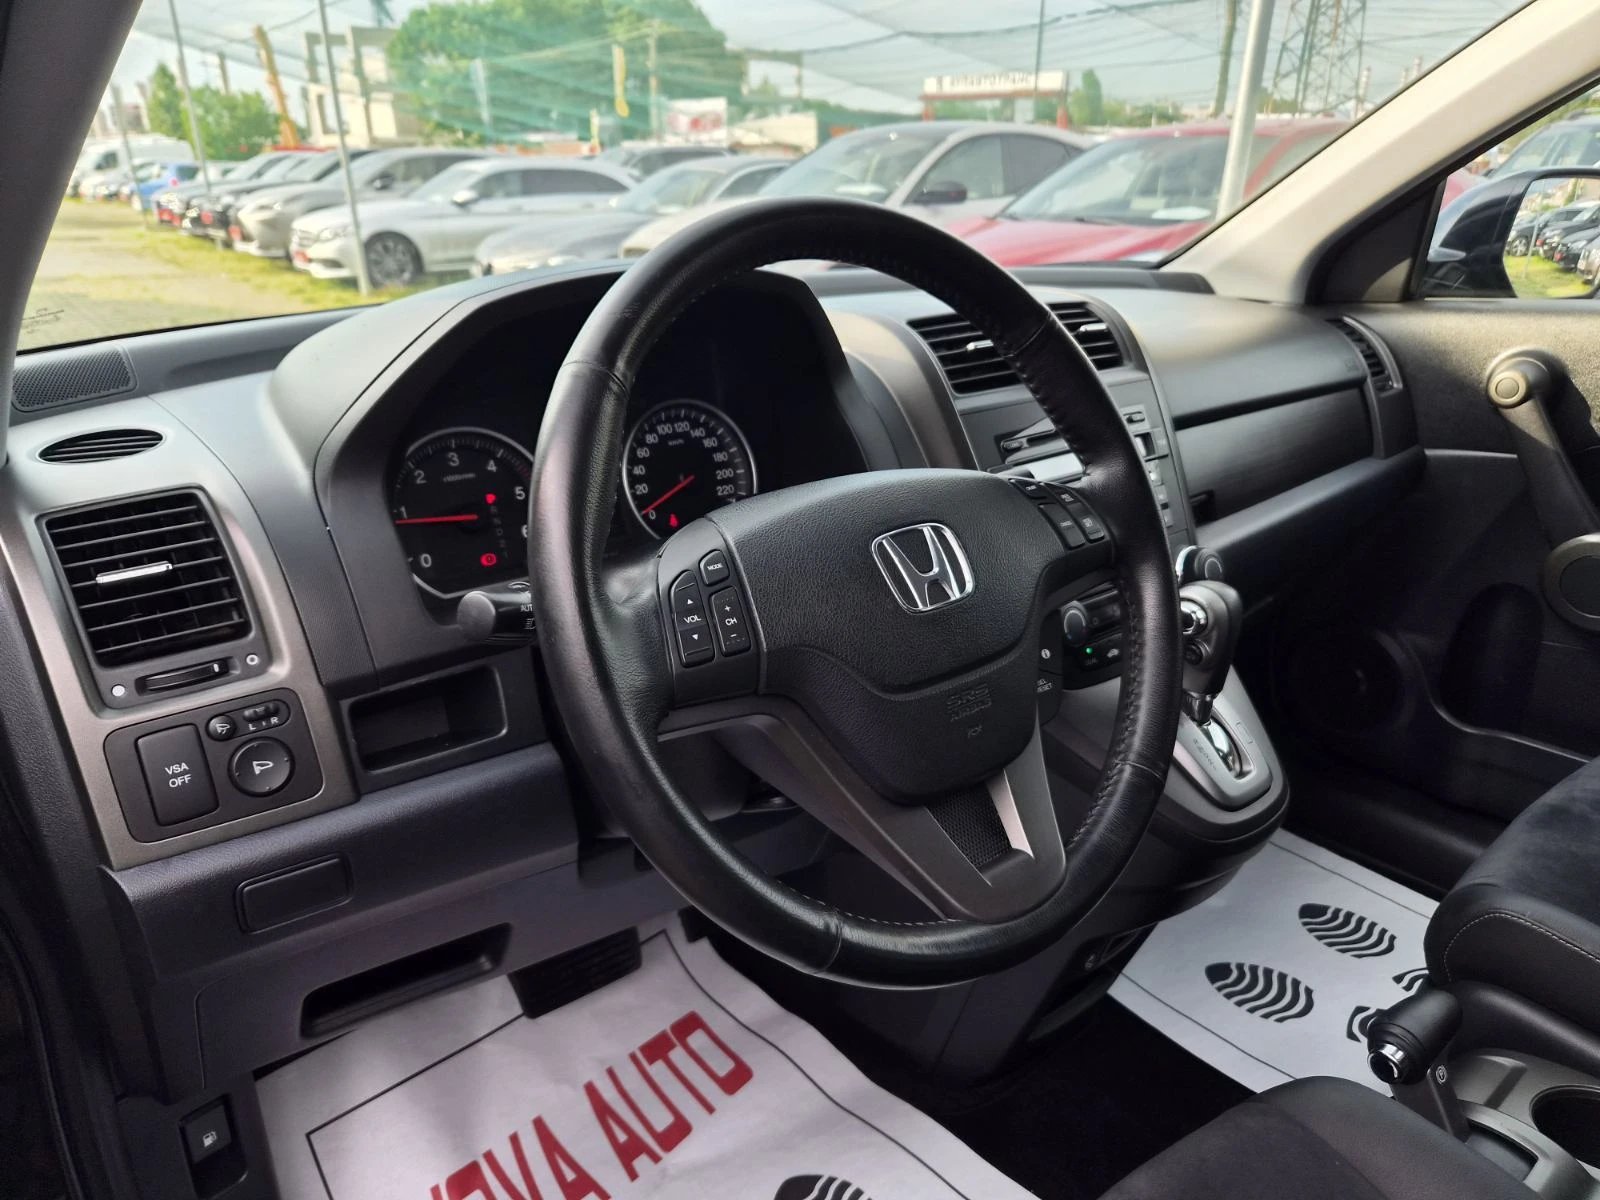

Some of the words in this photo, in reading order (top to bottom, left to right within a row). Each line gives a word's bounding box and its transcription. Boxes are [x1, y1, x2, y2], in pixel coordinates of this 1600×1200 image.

[656, 423, 673, 435] 100
[674, 421, 690, 433] 120
[690, 427, 706, 439] 140
[645, 433, 659, 444] 80
[702, 437, 718, 449] 160
[636, 447, 650, 458] 60
[712, 451, 729, 463] 180
[447, 452, 460, 467] 3
[486, 459, 498, 473] 4
[632, 464, 646, 476] 40
[414, 470, 427, 484] 2
[715, 468, 734, 480] 200
[514, 486, 526, 500] 5
[634, 483, 649, 495] 20
[716, 484, 735, 496] 220
[400, 505, 408, 519] 1
[648, 510, 657, 520] 0
[420, 553, 433, 568] 0
[706, 562, 724, 571] MODE
[683, 614, 702, 624] VOL
[725, 617, 738, 626] CH
[248, 723, 256, 731] L
[270, 716, 279, 725] R
[165, 762, 189, 775] VSA
[169, 774, 192, 788] OFF
[430, 1115, 612, 1200] VA
[583, 1010, 754, 1182] AUTO
